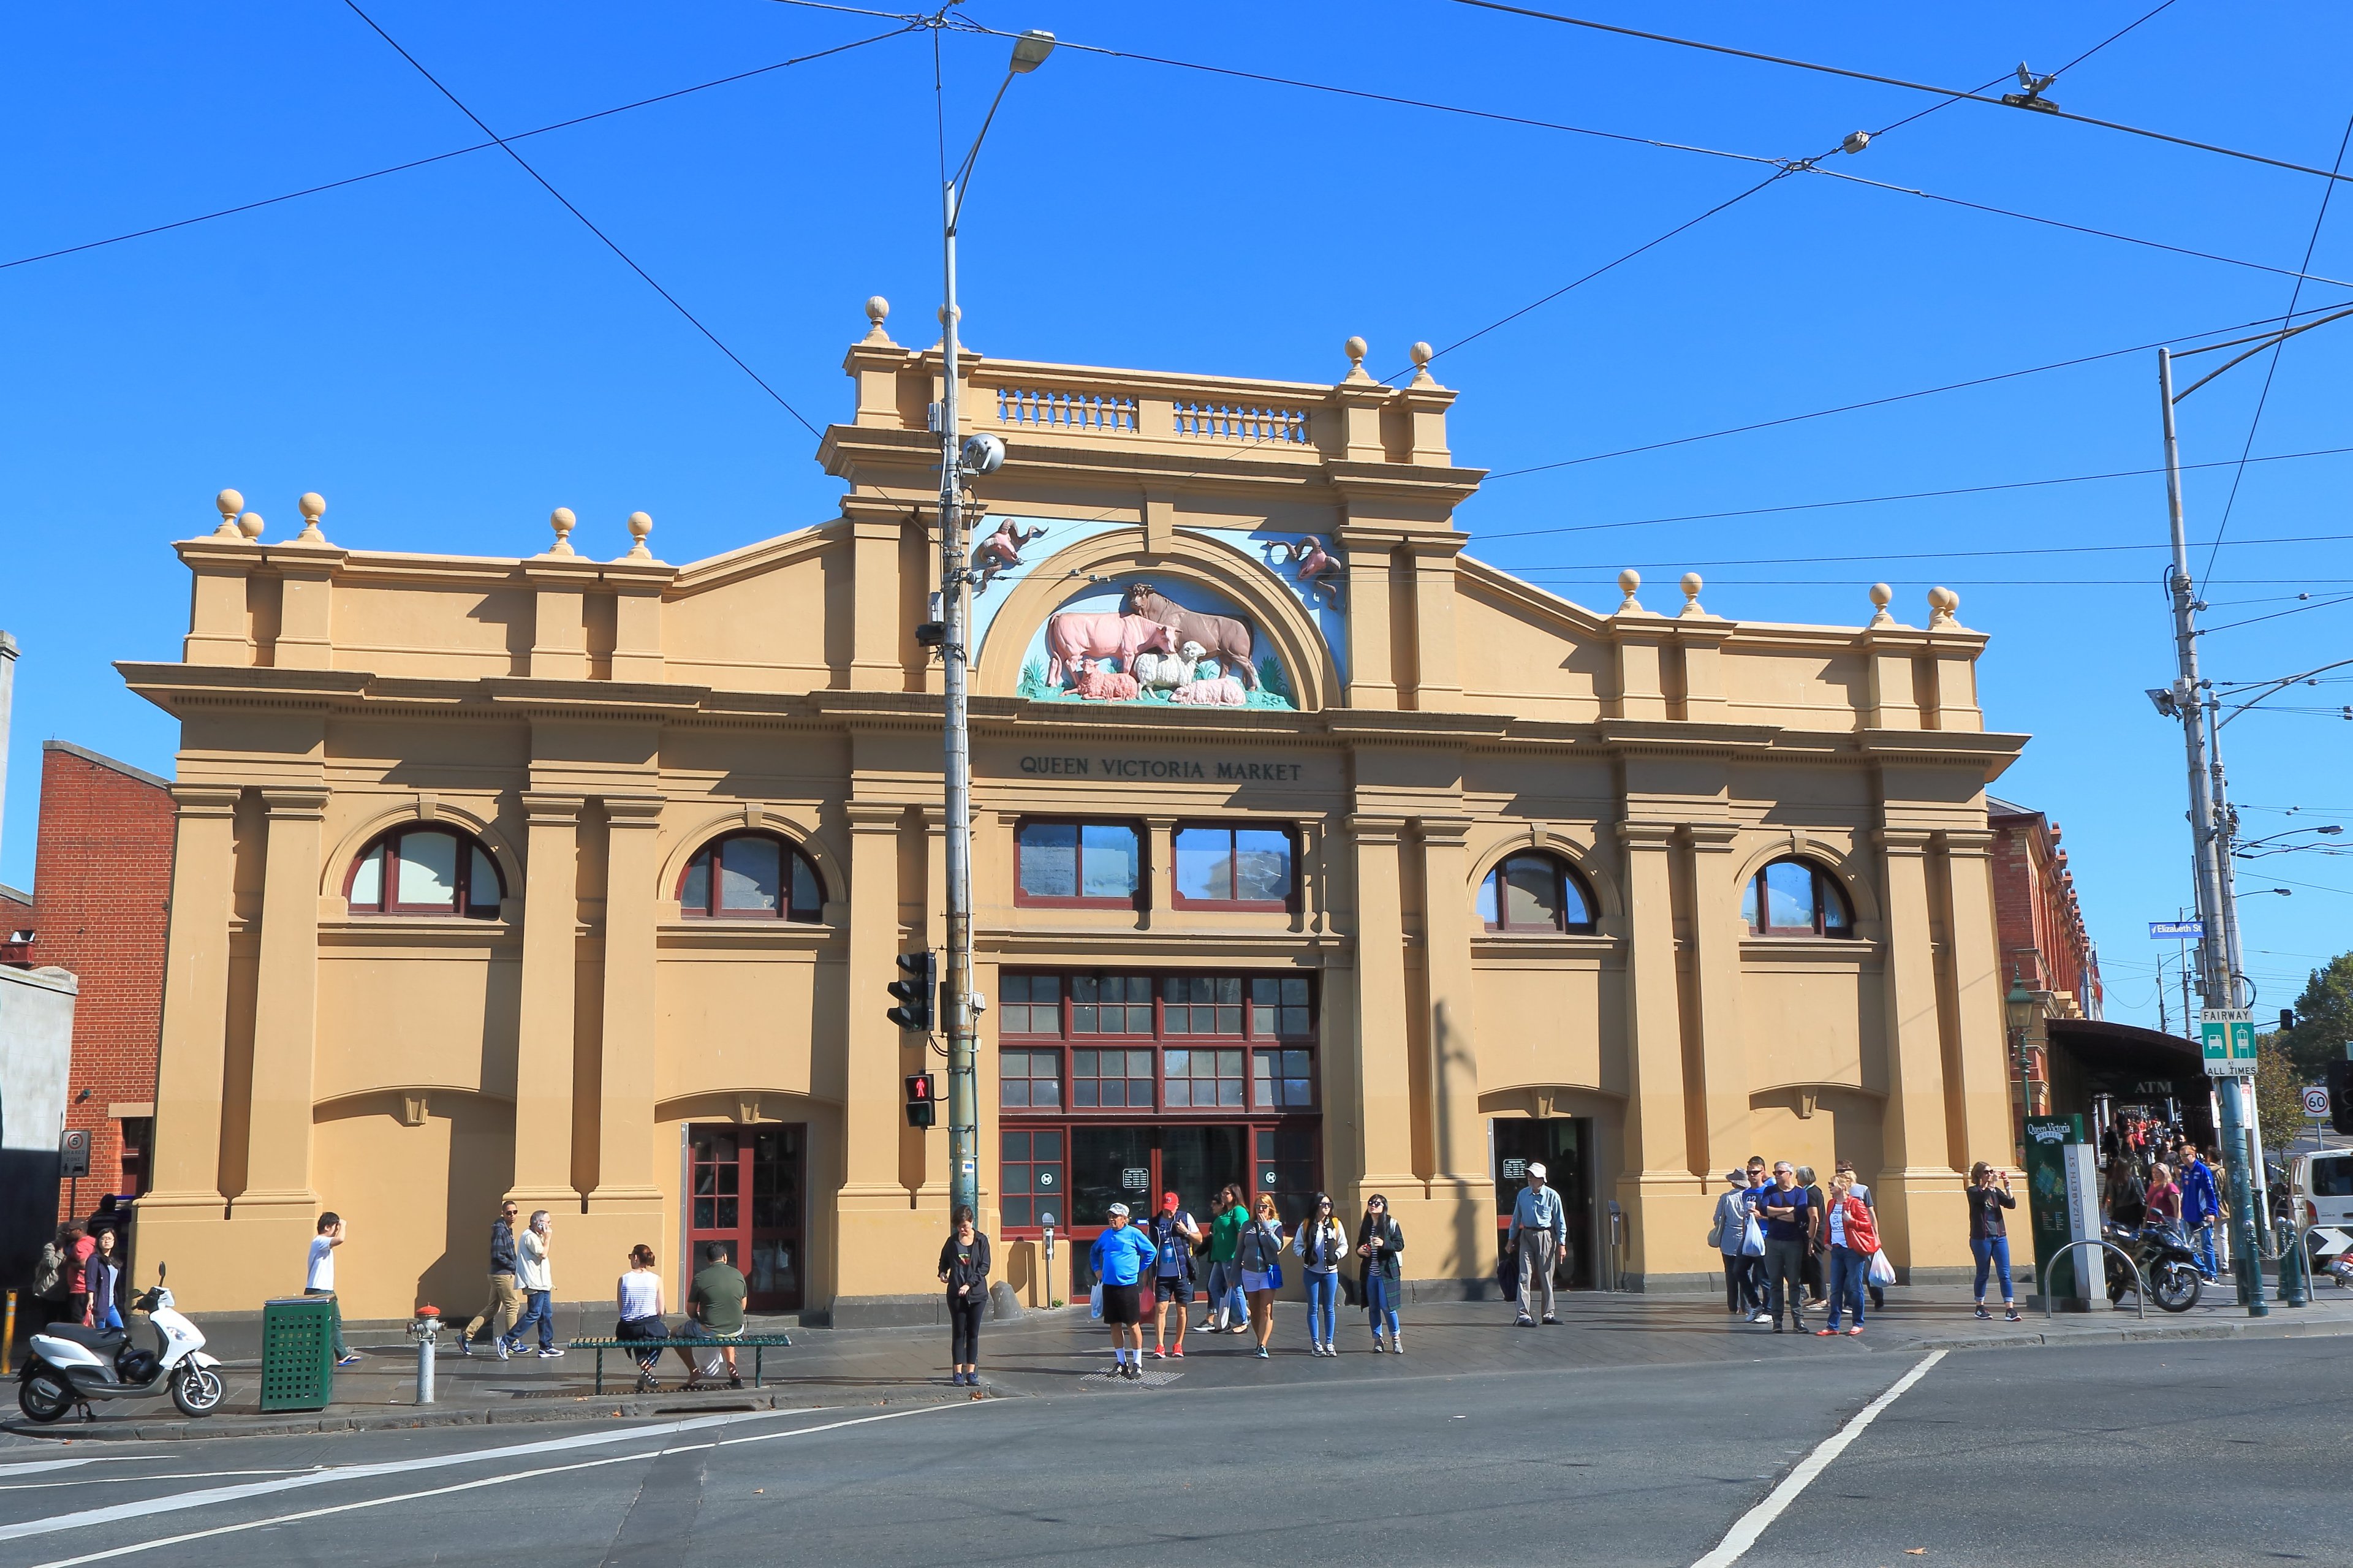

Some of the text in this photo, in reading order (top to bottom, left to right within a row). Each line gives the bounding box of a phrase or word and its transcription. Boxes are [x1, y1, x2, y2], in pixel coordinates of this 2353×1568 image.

[1020, 756, 1302, 781] QUEEN VICTORIA MARKET
[2157, 924, 2191, 933] Elizabeth
[2204, 1011, 2248, 1021] FAIRWAY
[2134, 1081, 2173, 1093] ATM
[2308, 1097, 2325, 1107] 60
[2028, 1123, 2071, 1135] Queen Victoria
[2069, 1155, 2080, 1229] ELIZABETH ST
